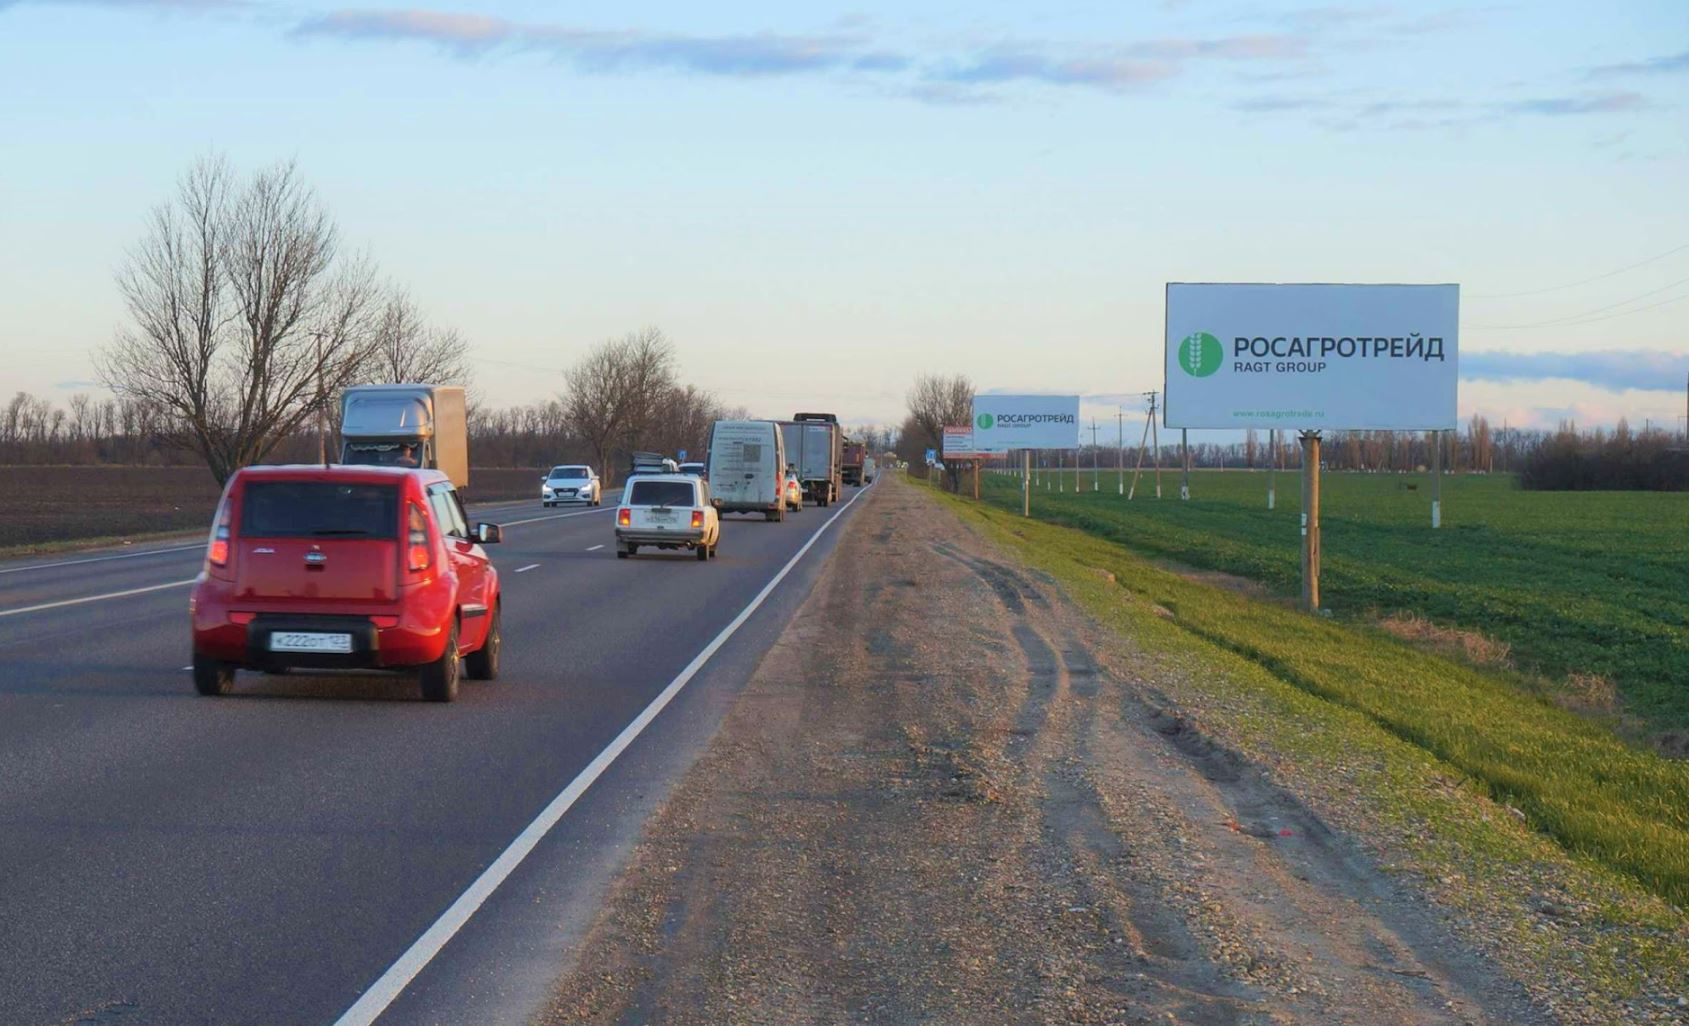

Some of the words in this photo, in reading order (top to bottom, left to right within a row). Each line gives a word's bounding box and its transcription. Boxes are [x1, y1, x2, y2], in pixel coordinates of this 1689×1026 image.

[1234, 332, 1444, 361] РОСАГРОТРЕЙД
[1234, 362, 1271, 373] RAGT
[1276, 362, 1327, 373] GROUP
[997, 413, 1074, 424] РОСАГРОТРЕЙД
